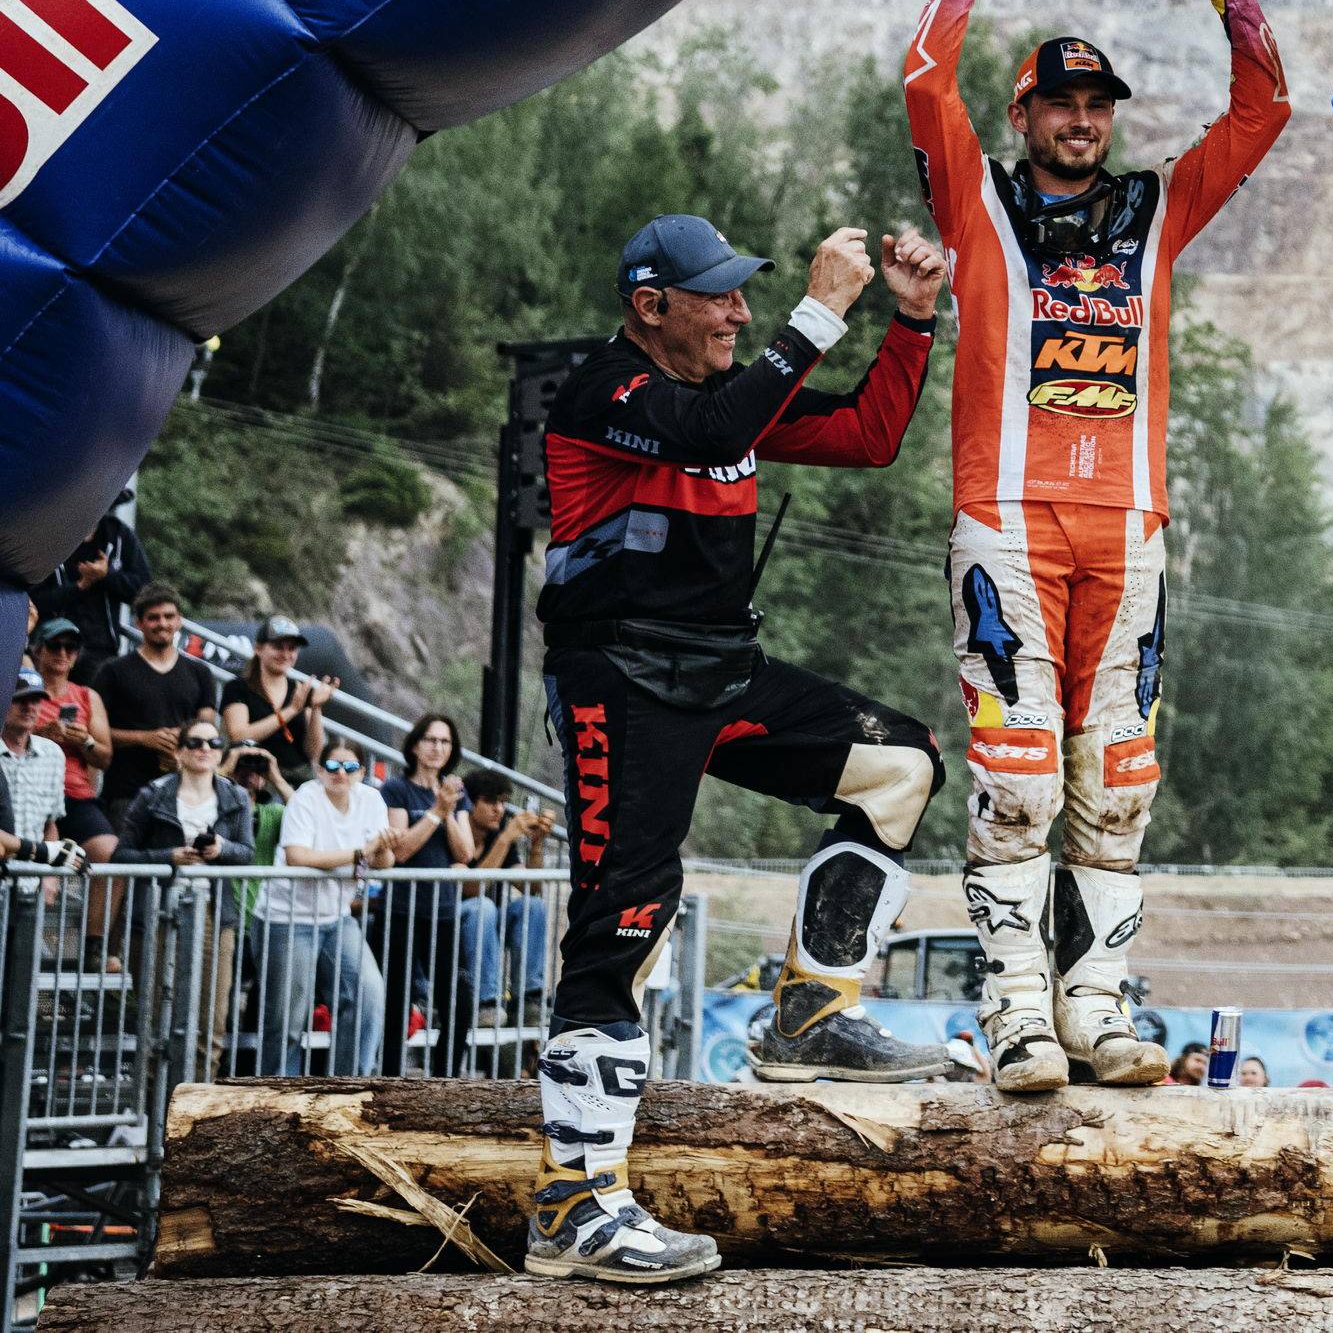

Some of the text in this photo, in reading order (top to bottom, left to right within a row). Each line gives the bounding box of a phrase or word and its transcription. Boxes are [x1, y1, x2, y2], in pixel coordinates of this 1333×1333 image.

[1032, 289, 1144, 329] Red Bull
[1034, 330, 1138, 376] KTM
[1029, 384, 1137, 411] FMF
[604, 425, 661, 455] KINI
[570, 703, 612, 867] KINI
[615, 927, 652, 939] KINI
